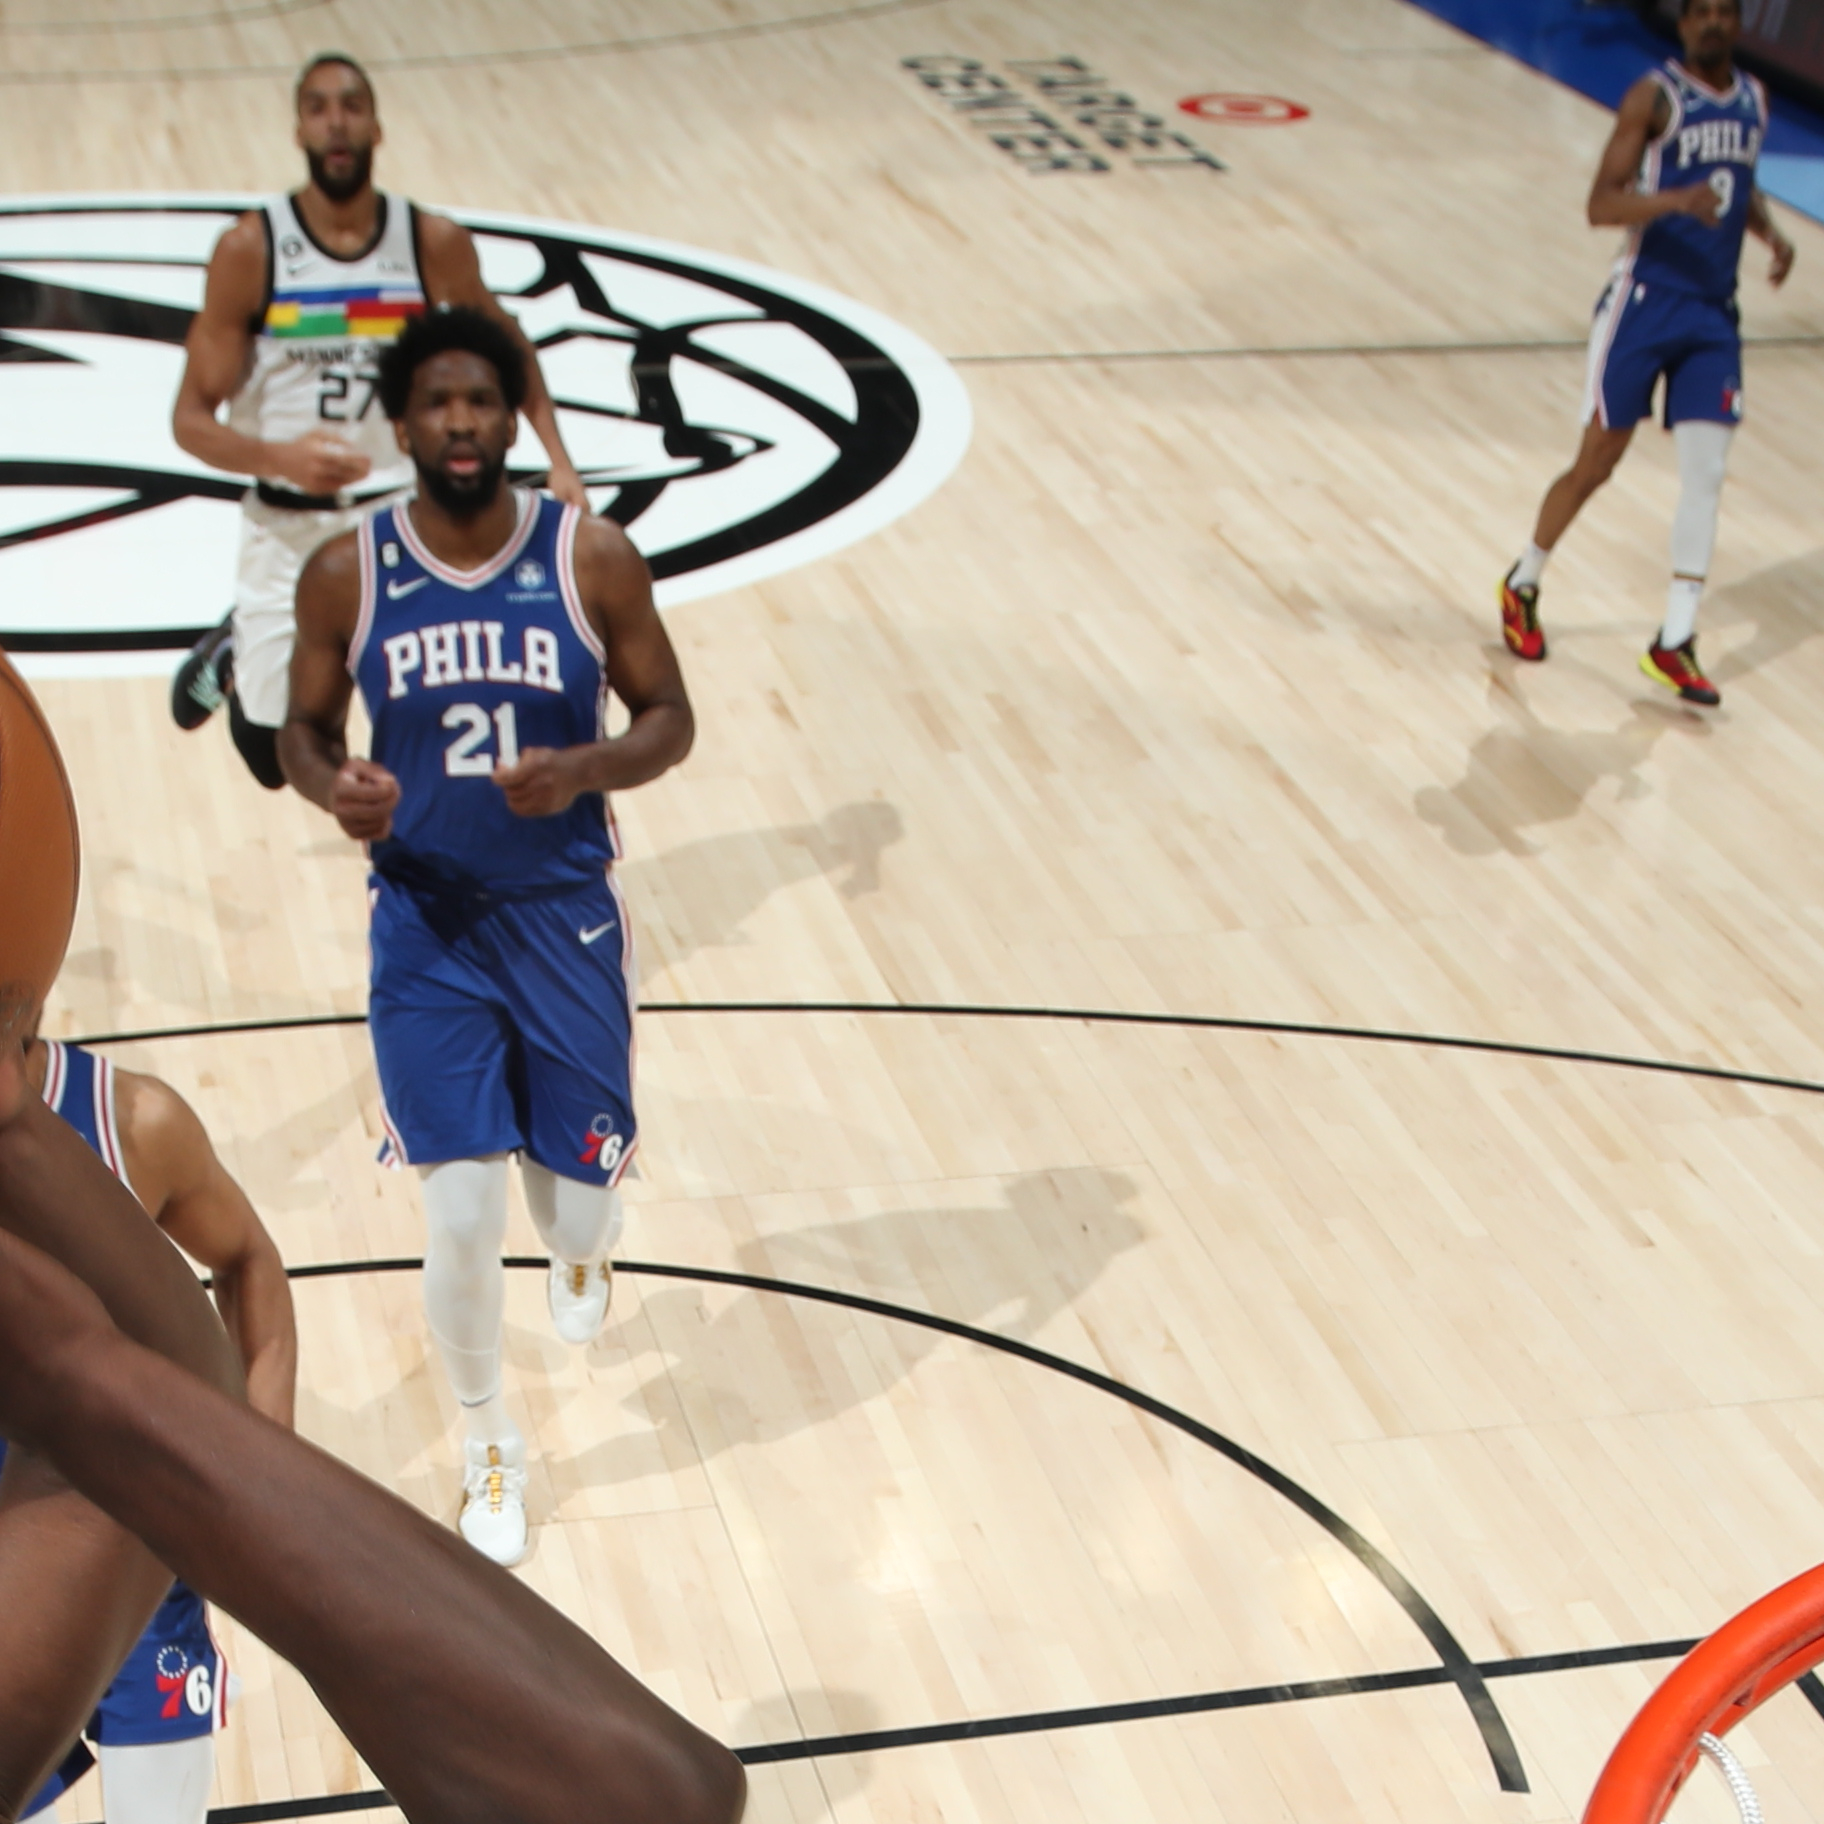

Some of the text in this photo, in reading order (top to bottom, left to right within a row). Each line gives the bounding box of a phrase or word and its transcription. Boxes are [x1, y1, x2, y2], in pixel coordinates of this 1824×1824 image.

[319, 370, 382, 421] 27
[382, 620, 565, 700] PHILA
[441, 701, 521, 777] 21
[156, 1664, 212, 1719] 76
